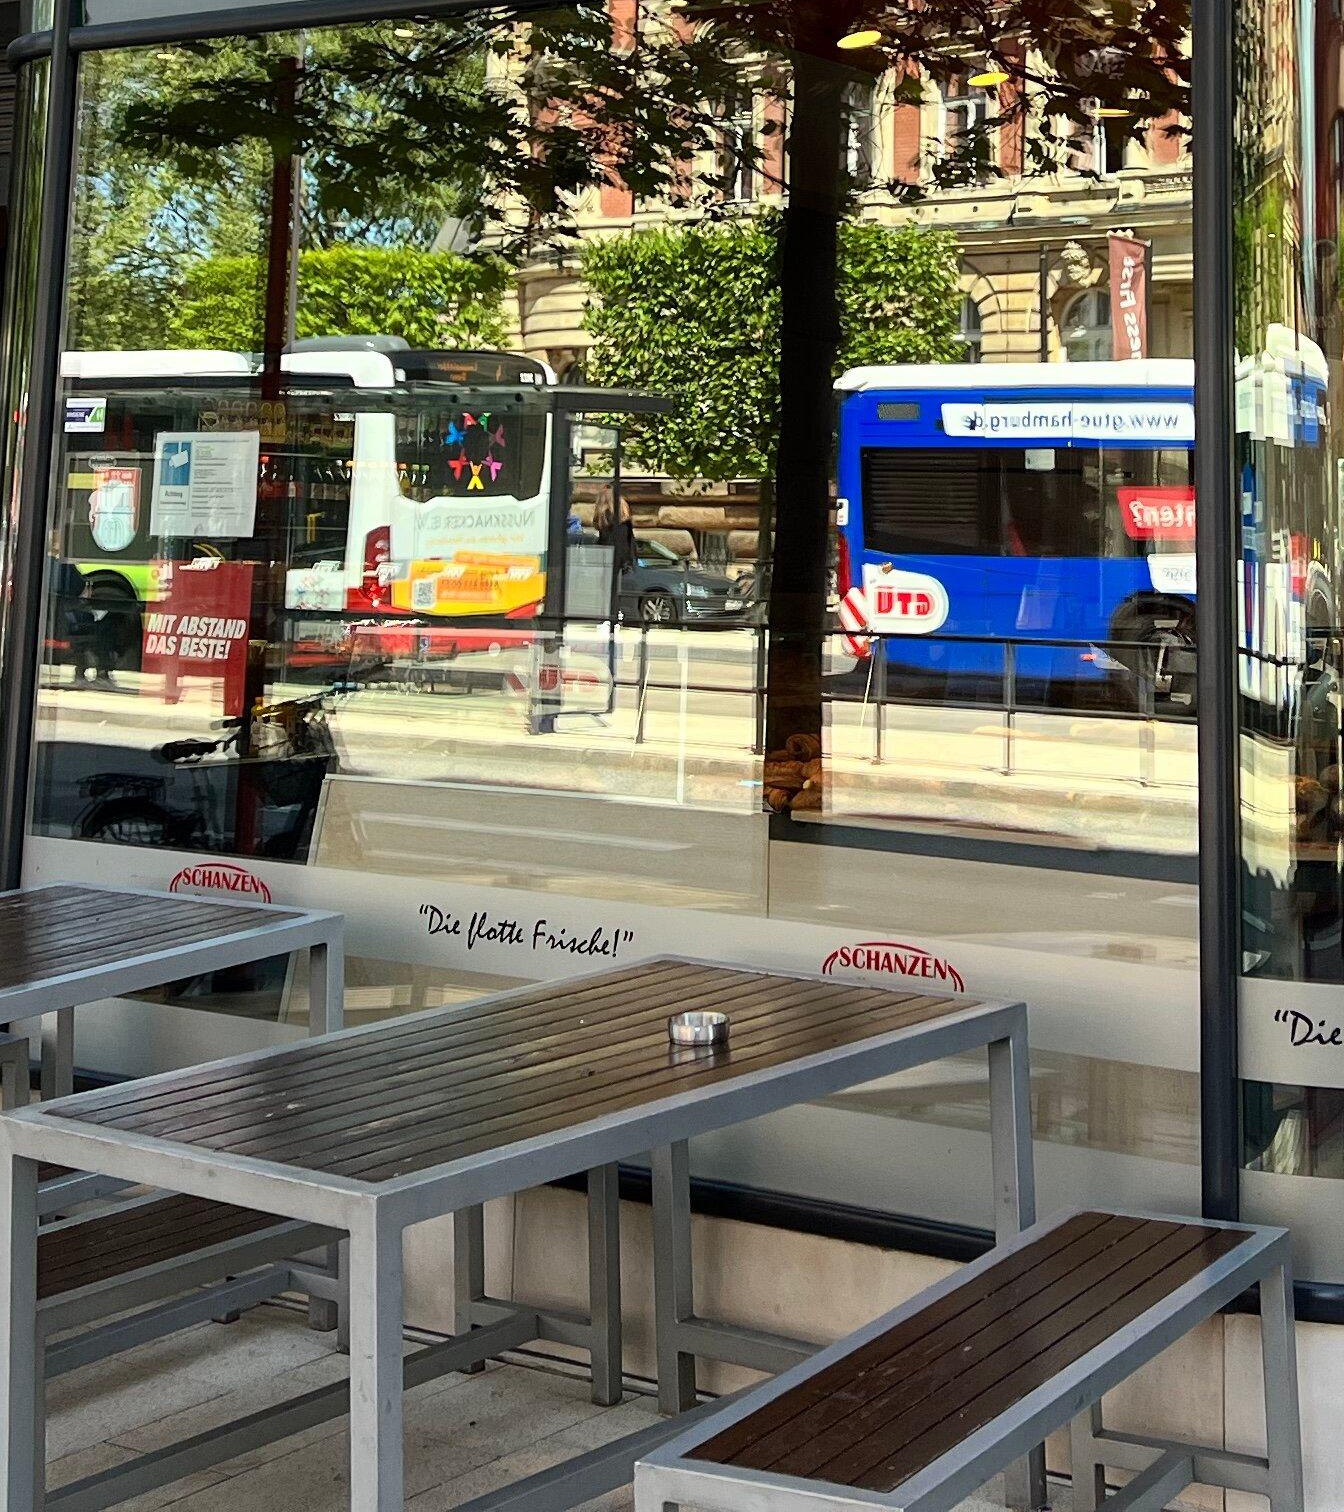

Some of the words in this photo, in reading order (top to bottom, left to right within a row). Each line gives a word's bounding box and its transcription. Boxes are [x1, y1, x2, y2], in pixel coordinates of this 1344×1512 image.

[146, 613, 178, 635] MIT
[176, 615, 247, 639] ABSTAND
[145, 634, 178, 655] DAS
[178, 638, 232, 660] BESTE!
[182, 866, 261, 894] SCHANZEN
[467, 911, 524, 951] flotte
[532, 919, 635, 958] Frische!"
[839, 945, 948, 981] SCHANZEN
